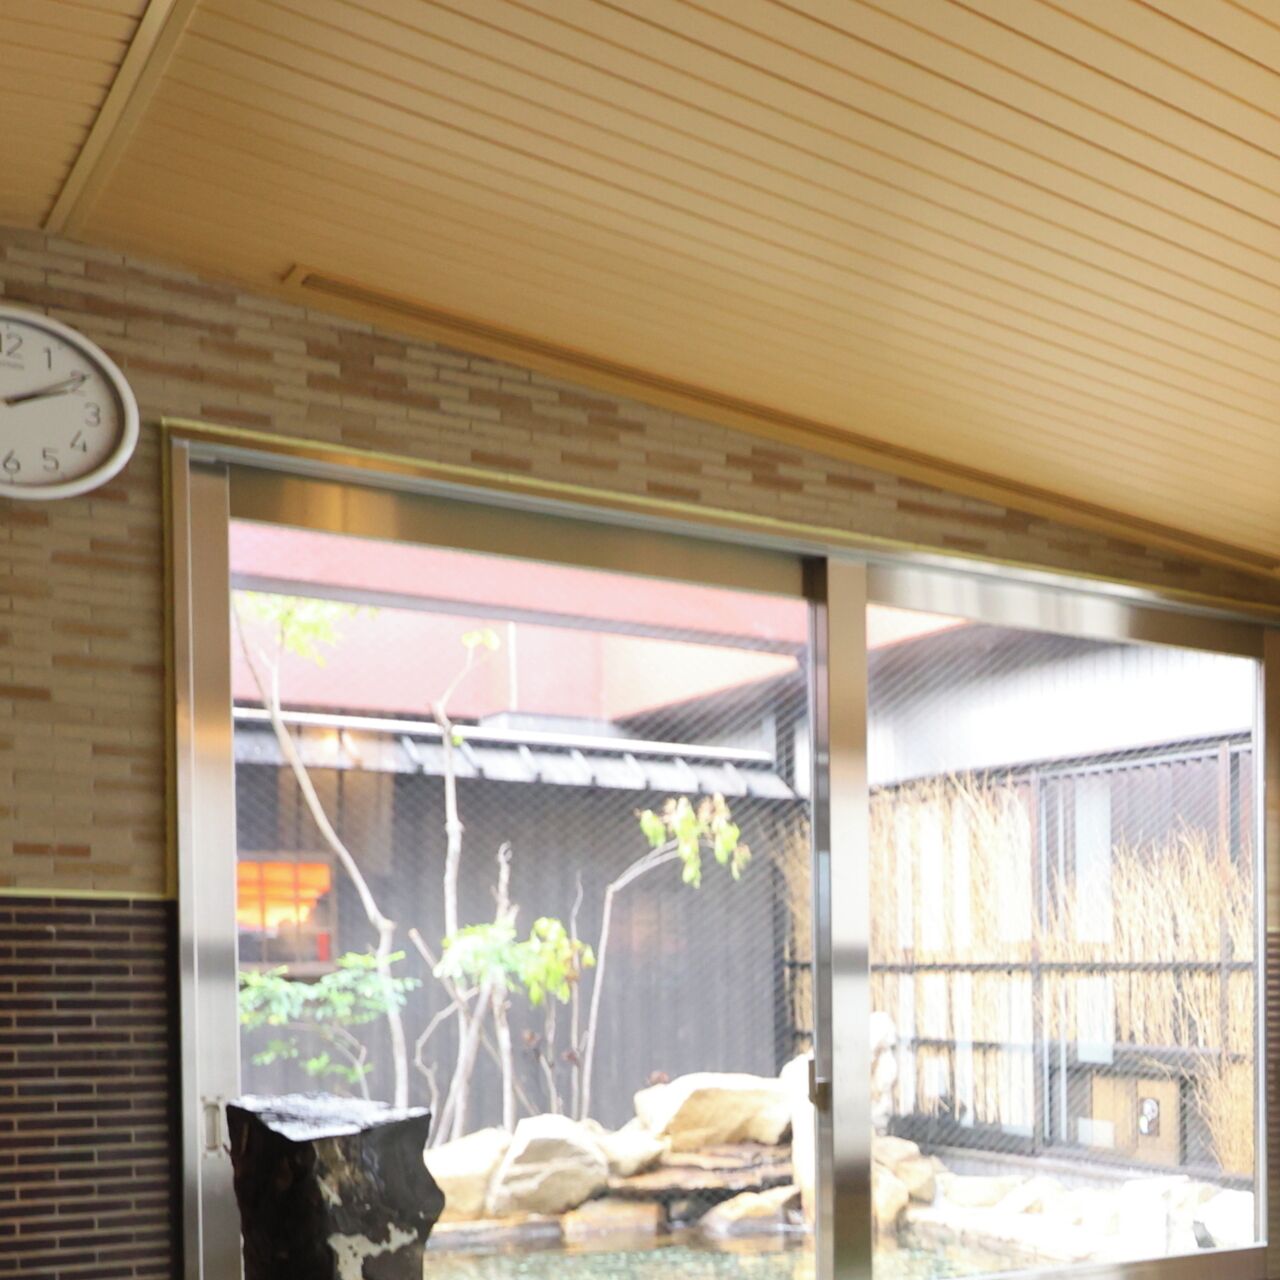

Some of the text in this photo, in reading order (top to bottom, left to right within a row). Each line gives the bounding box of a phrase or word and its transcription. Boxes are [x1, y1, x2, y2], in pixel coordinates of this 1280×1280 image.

[44, 346, 52, 370] 1
[84, 402, 101, 428] 3
[70, 430, 87, 453] 4
[2, 449, 21, 474] 6
[42, 448, 60, 472] 5
